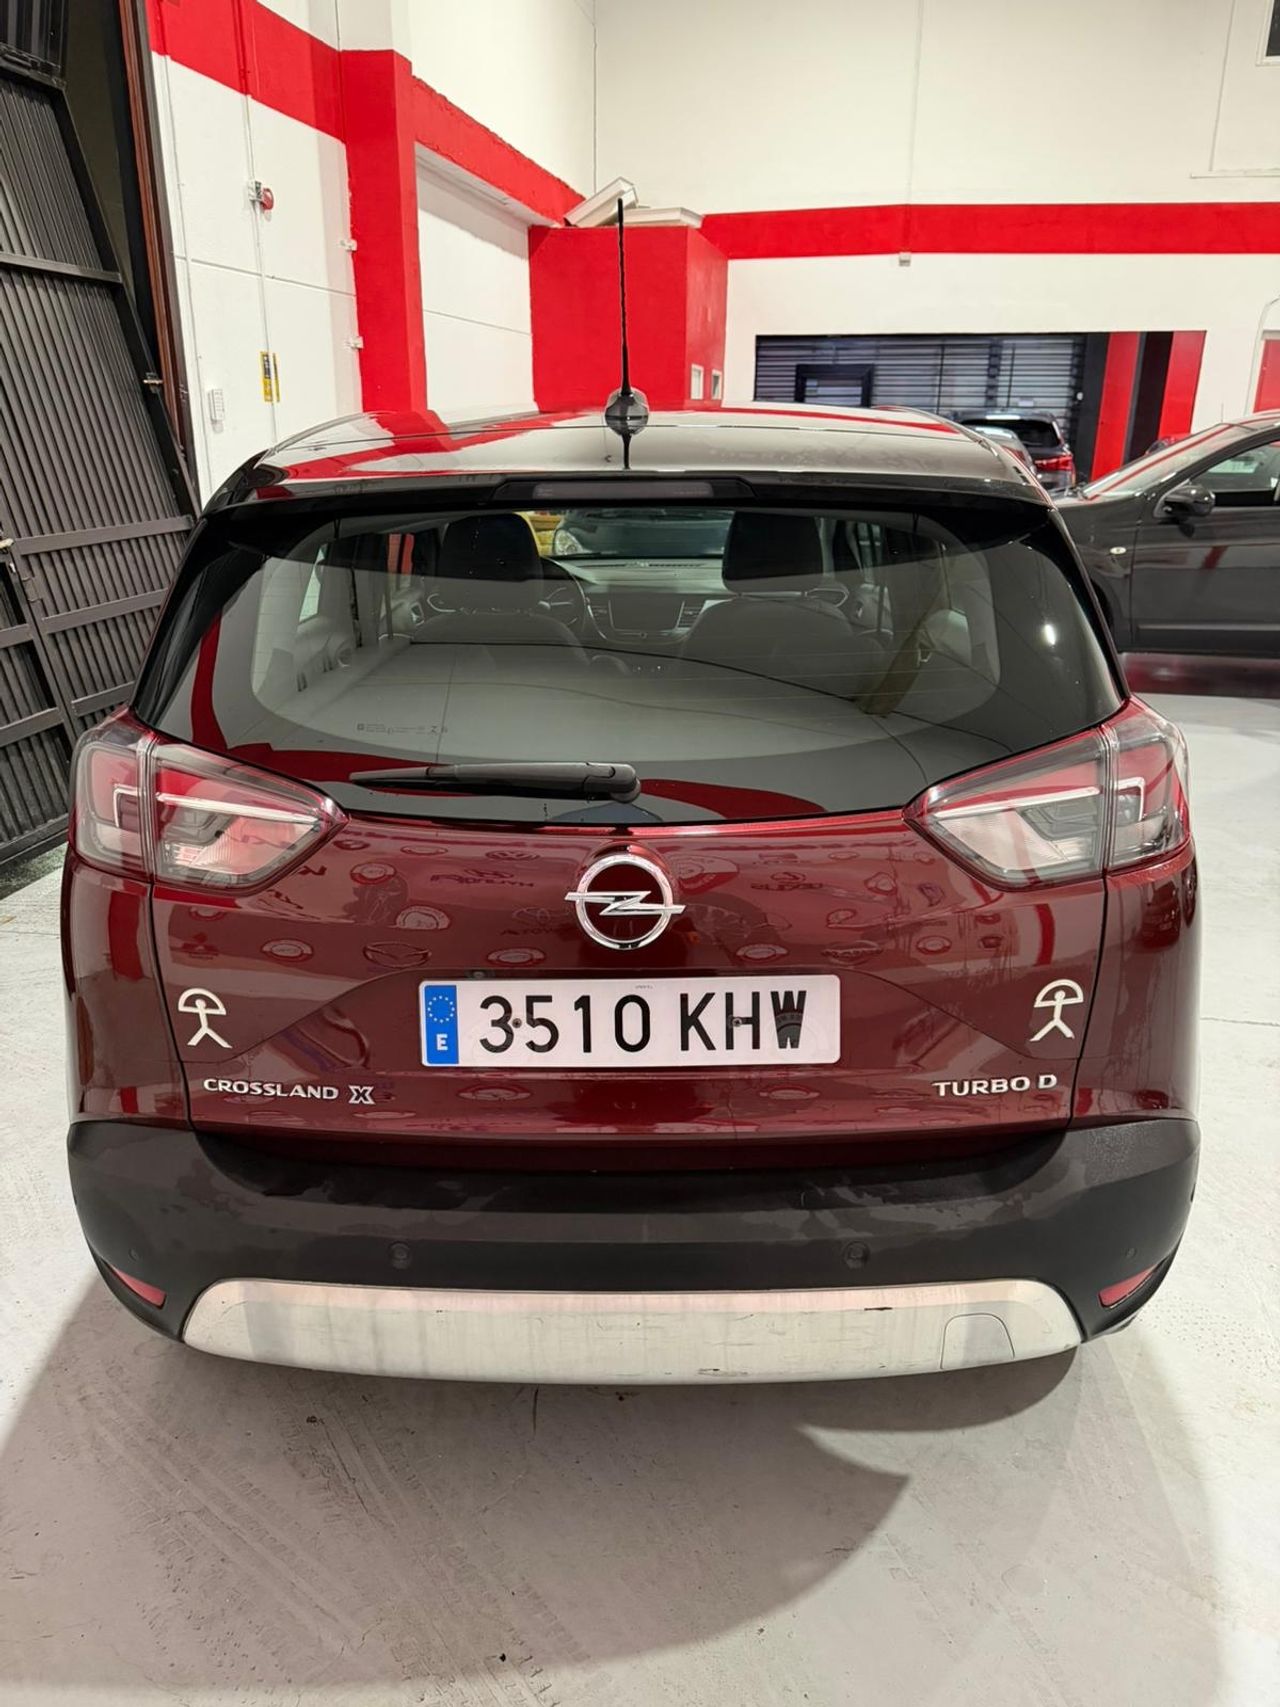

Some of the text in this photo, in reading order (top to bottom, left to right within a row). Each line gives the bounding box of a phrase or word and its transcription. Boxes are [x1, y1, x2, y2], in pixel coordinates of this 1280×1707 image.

[479, 990, 807, 1053] 3510 KHW
[437, 1034, 448, 1051] E
[203, 1078, 375, 1104] CROSSLAND X
[932, 1074, 1057, 1096] TURBO D
